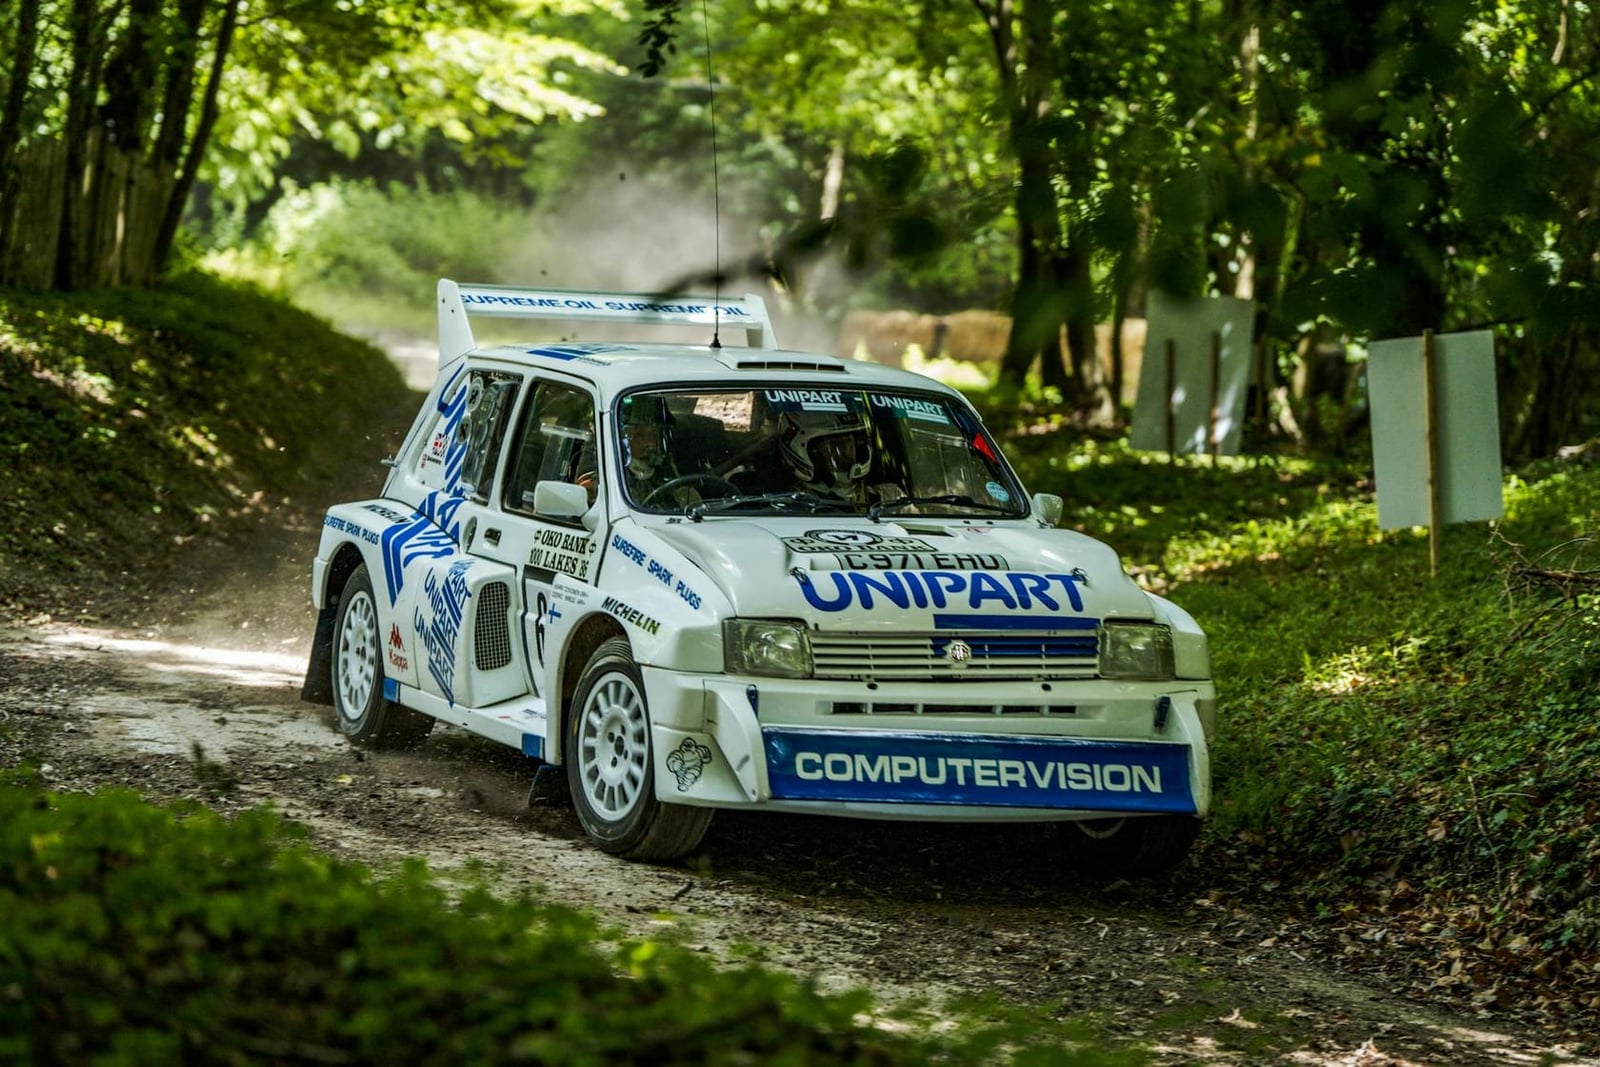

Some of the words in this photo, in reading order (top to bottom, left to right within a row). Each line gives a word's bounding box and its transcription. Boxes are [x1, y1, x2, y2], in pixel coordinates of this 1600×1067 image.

[460, 294, 565, 307] SUPREME
[564, 299, 602, 309] OIL
[764, 390, 843, 403] UNIPART
[871, 394, 943, 415] UNIPART
[345, 521, 361, 537] SPARK
[361, 528, 380, 545] PLUGS
[541, 529, 563, 548] OKO
[561, 534, 590, 555] BANK
[529, 548, 543, 566] 1000
[543, 550, 578, 575] LAKES
[611, 534, 647, 567] SUREFIRE
[647, 559, 674, 586] SPARK
[675, 580, 702, 610] PLUGS
[844, 553, 924, 570] C971
[931, 553, 1000, 570] EHU
[796, 571, 1084, 612] UNIPART
[424, 566, 458, 650] UNIPART
[601, 596, 662, 636] MICHELIN
[388, 647, 408, 673] Kappa
[414, 604, 455, 690] UNIPART
[794, 751, 1163, 793] COMPUTERVISION
